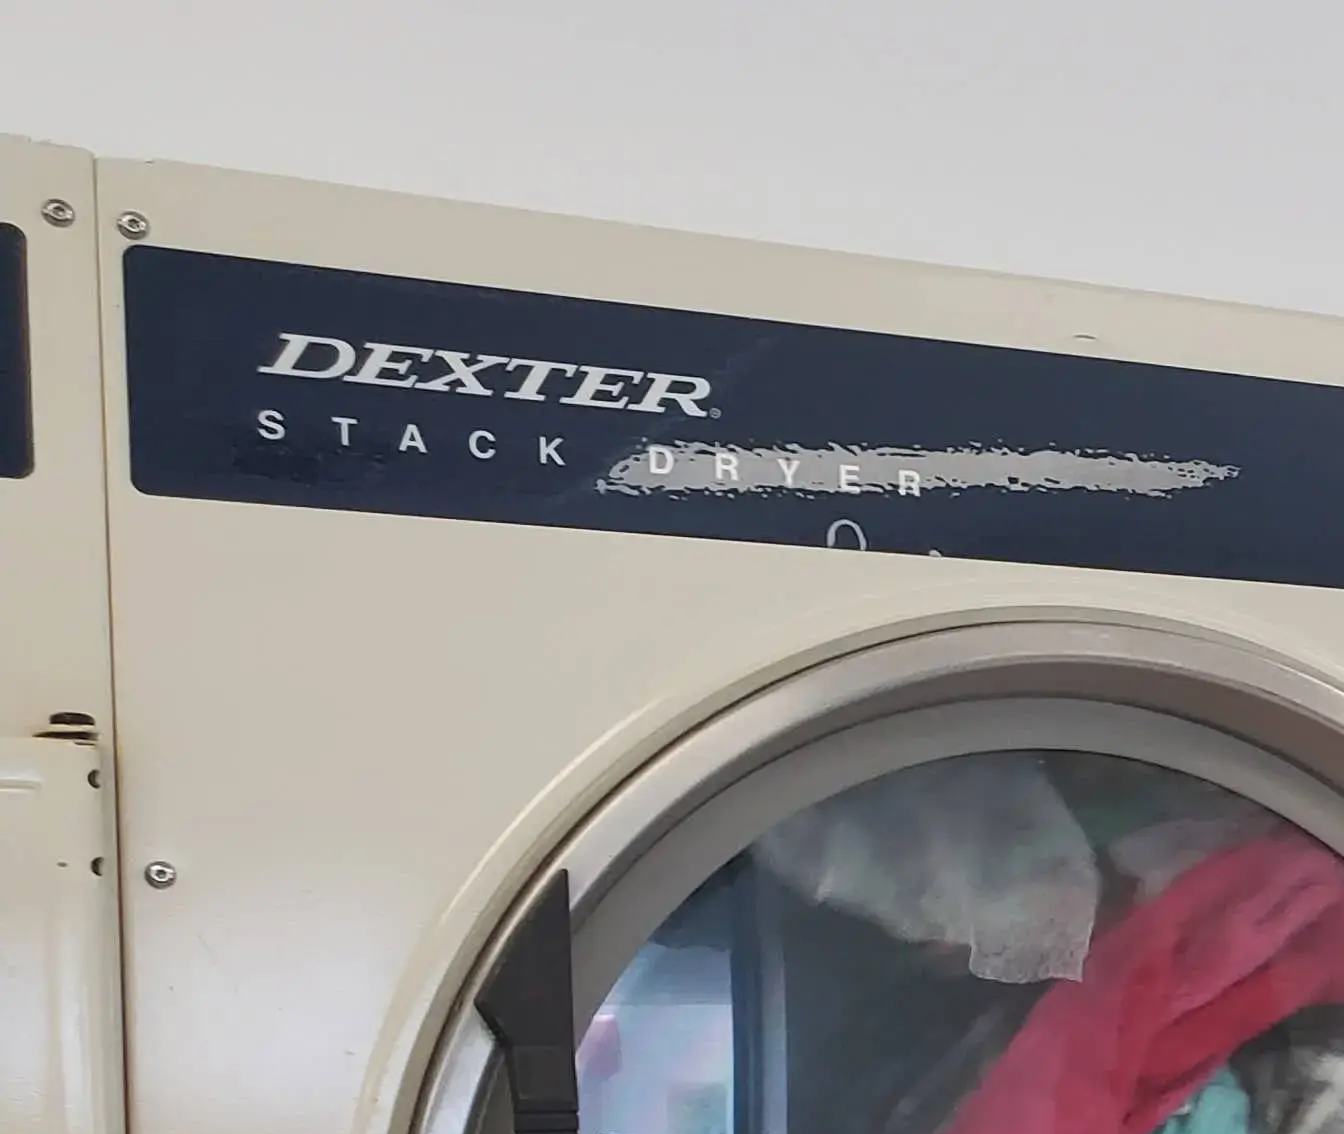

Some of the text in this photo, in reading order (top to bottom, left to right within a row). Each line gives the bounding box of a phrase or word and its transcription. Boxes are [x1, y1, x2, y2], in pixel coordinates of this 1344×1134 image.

[257, 333, 712, 417] DEXTER
[257, 409, 921, 497] STACK DRYER
